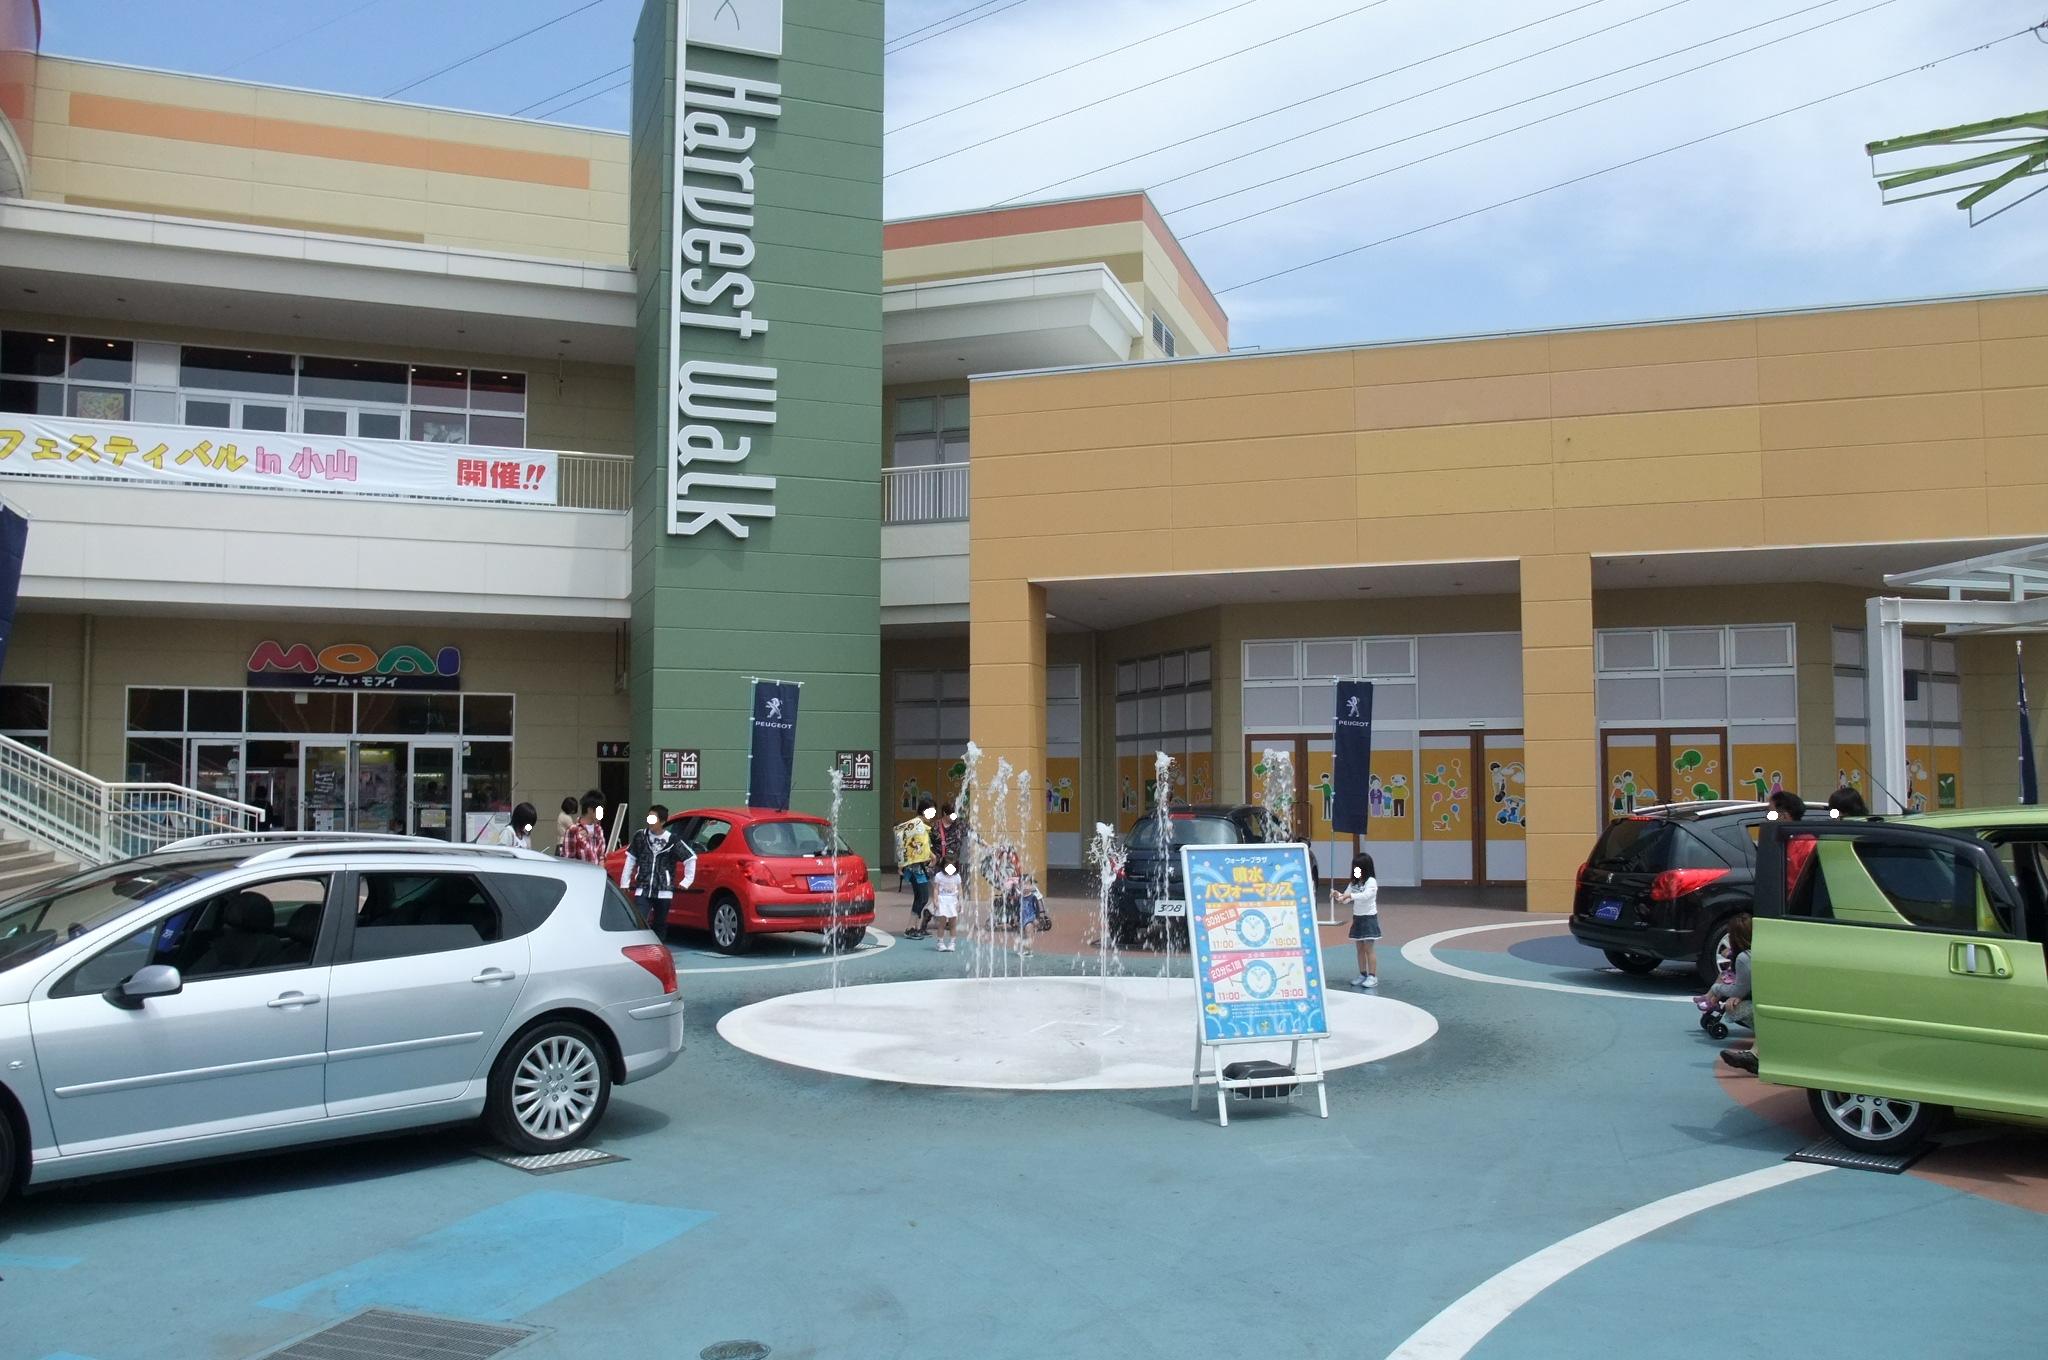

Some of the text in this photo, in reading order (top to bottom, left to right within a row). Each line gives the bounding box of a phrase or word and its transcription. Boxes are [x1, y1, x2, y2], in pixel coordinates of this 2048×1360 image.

[676, 69, 782, 538] Harvest Walk
[255, 446, 282, 475] in
[289, 446, 358, 481] 小山
[247, 640, 461, 676] MOAI
[755, 720, 793, 730] PEUGEOT
[1338, 719, 1369, 727] PEUGEOT
[1212, 940, 1234, 949] 11:00
[1217, 991, 1240, 1000] 11:00
